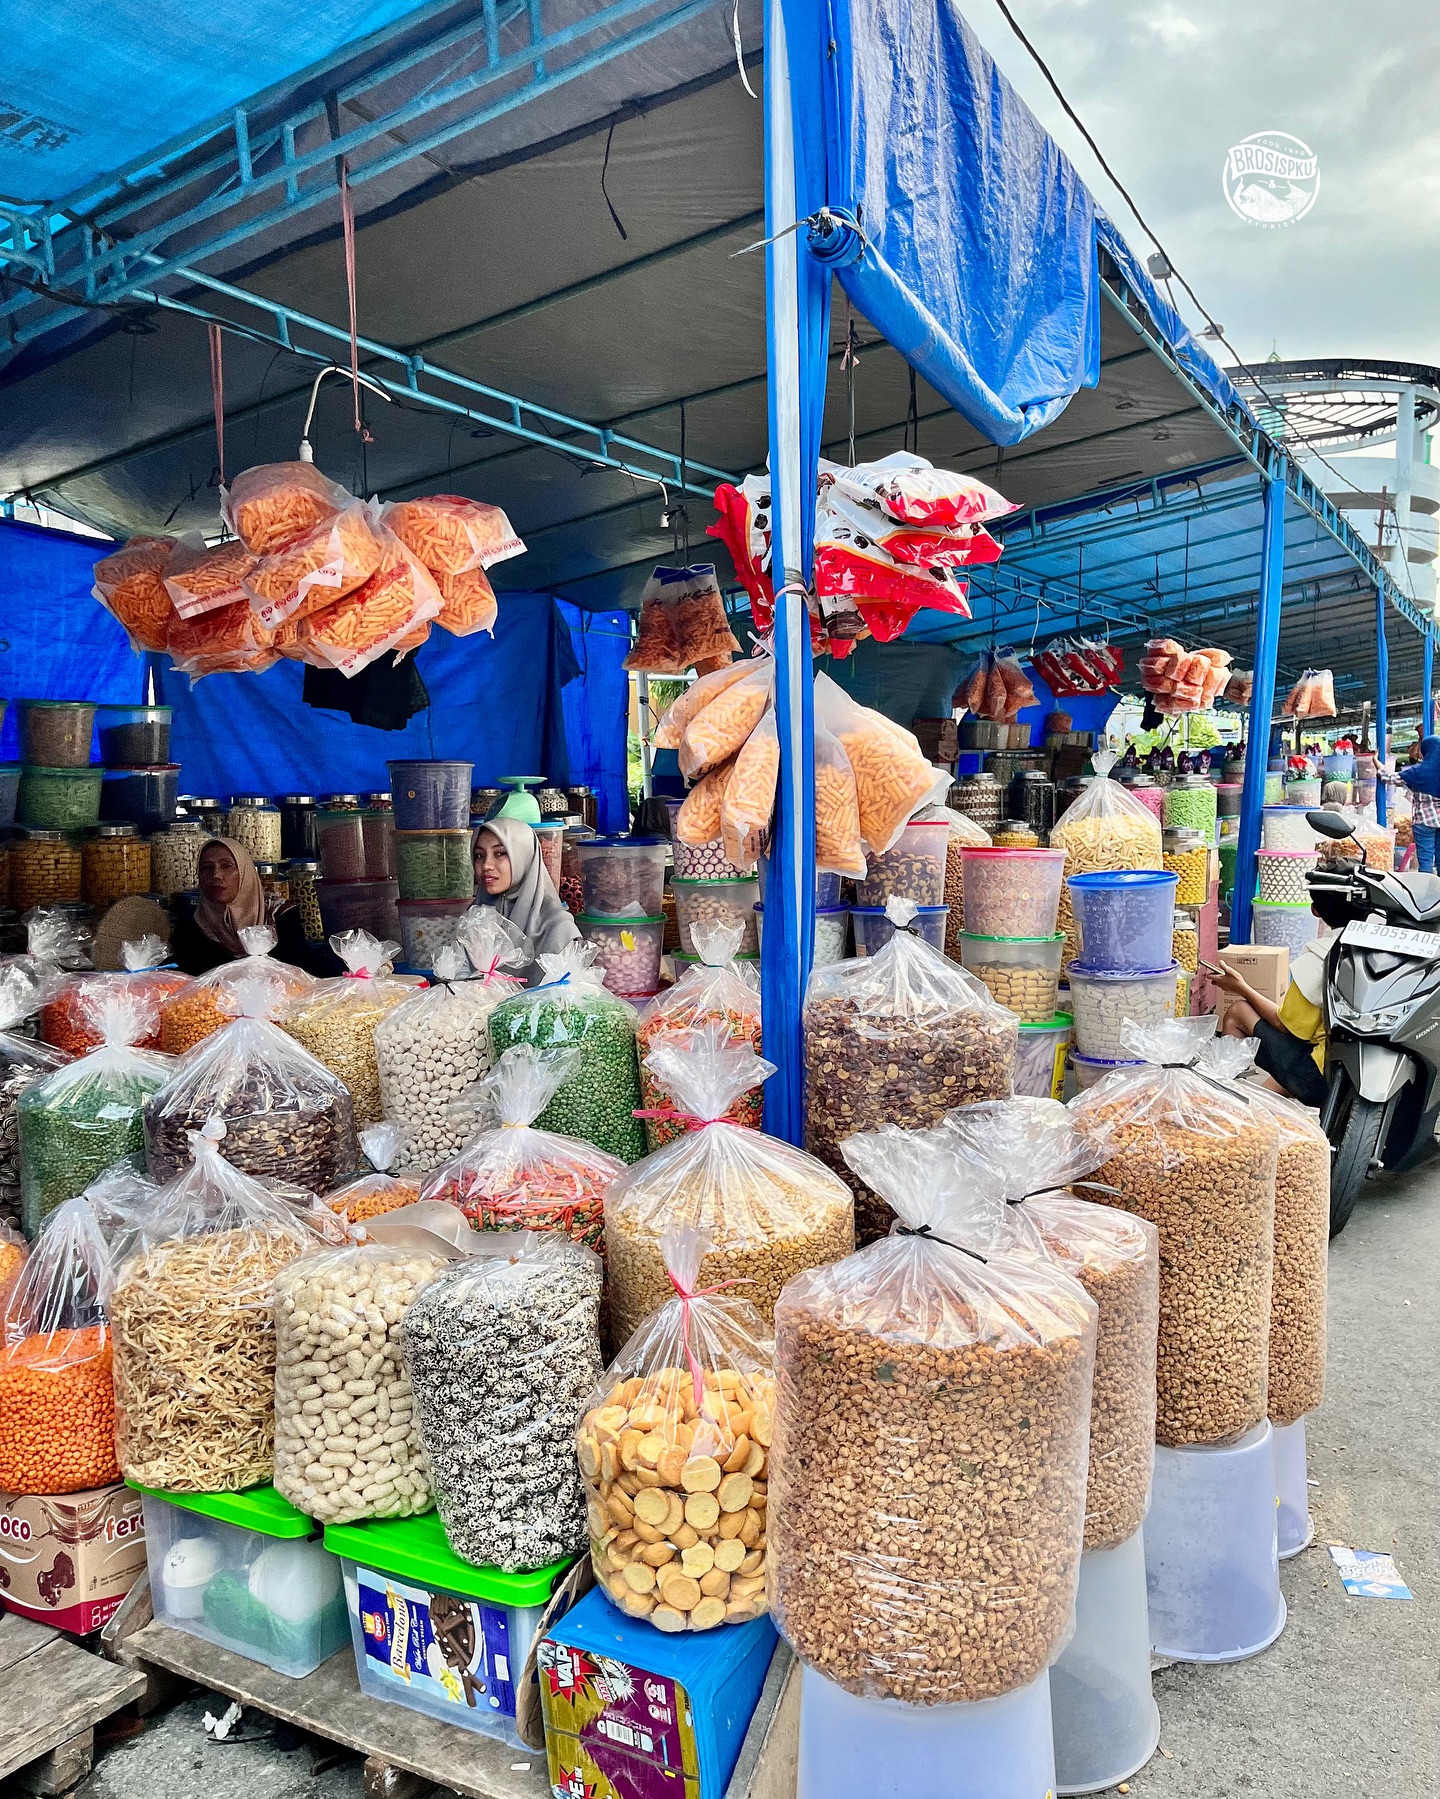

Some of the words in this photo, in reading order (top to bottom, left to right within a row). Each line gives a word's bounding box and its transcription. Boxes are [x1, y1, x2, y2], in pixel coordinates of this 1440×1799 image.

[1347, 921, 1368, 934] BM
[1370, 925, 1410, 940] 3055
[1415, 1021, 1439, 1040] HONDA
[392, 1597, 407, 1669] Barcelona
